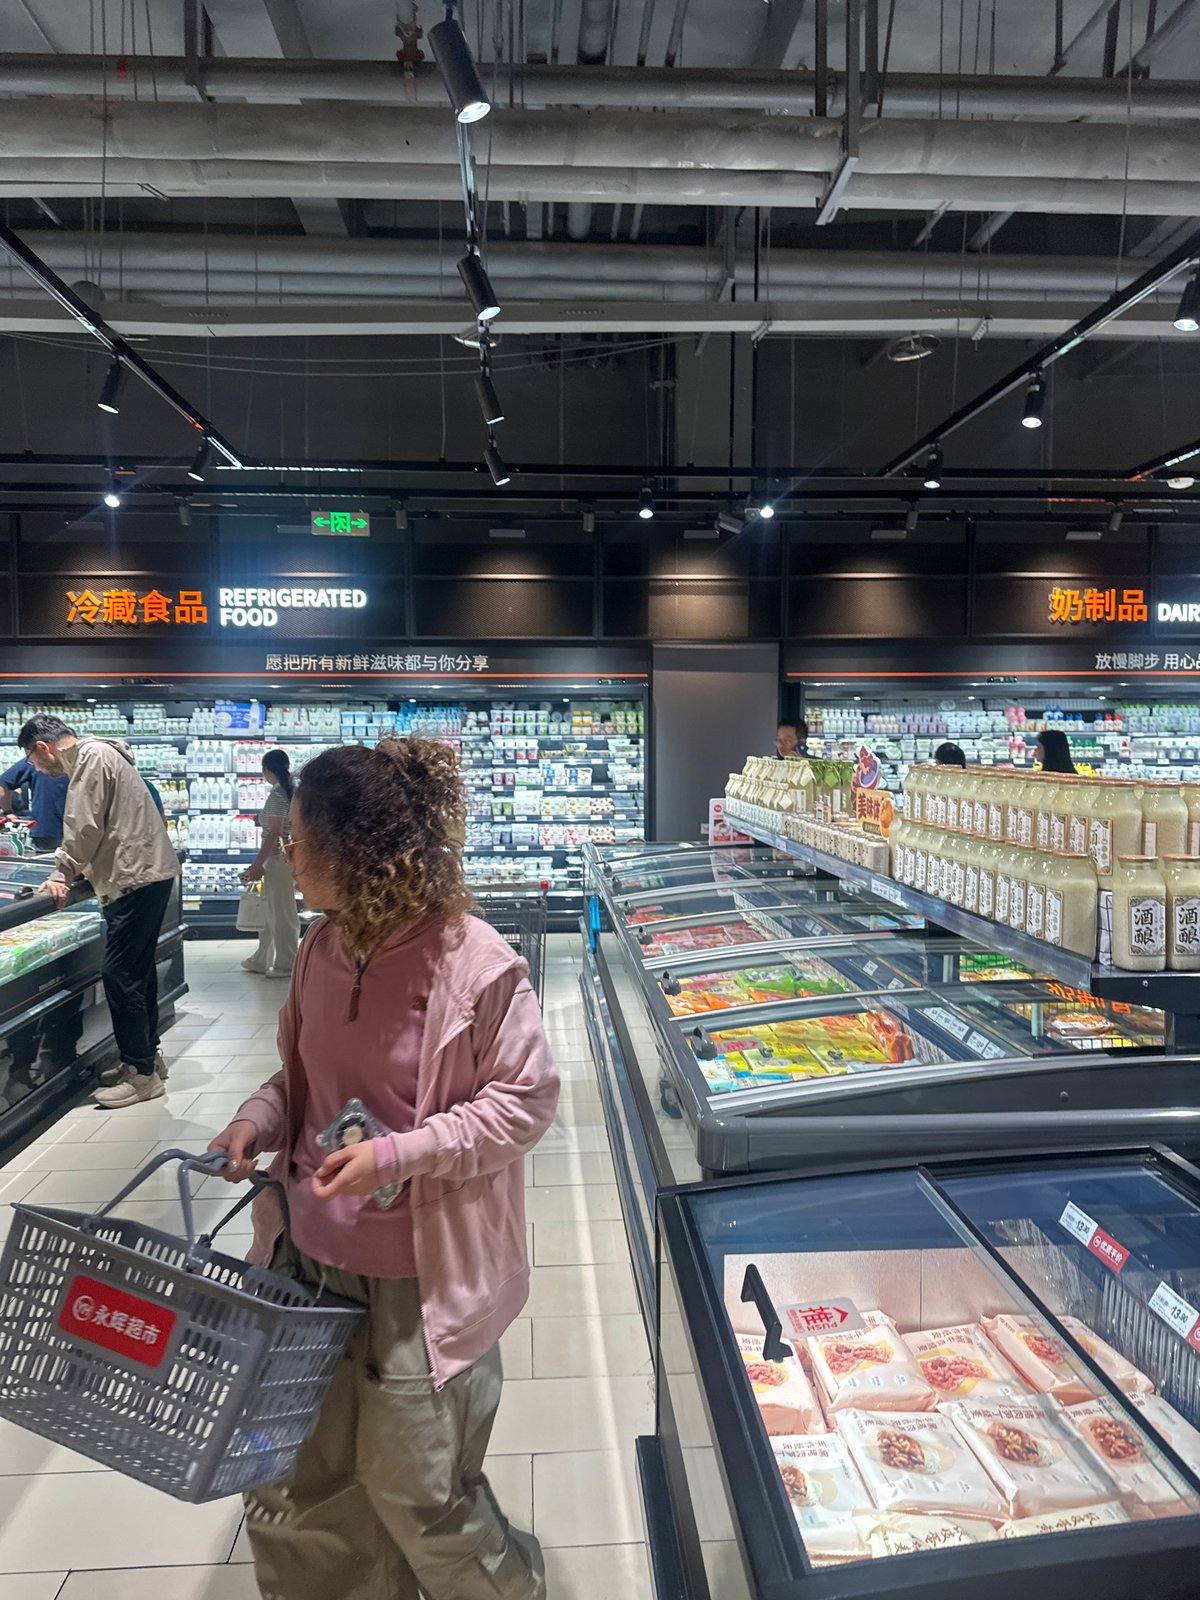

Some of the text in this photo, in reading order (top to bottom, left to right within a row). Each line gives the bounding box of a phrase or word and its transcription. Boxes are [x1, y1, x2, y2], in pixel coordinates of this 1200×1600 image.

[66, 588, 208, 625] 冷藏食品
[218, 587, 368, 608] REFRIGERATED
[1050, 587, 1149, 622] 奶制品
[218, 607, 279, 628] FOOD
[1157, 602, 1200, 622] DAIR
[265, 653, 490, 672] 愿把所有新鲜滋味都与你分享
[1095, 652, 1160, 670] 放慢脚步
[1134, 907, 1155, 945] 酒酿
[1178, 906, 1200, 944] 酒酿
[91, 1304, 161, 1345] 永辉超市
[806, 1321, 838, 1332] PUSH
